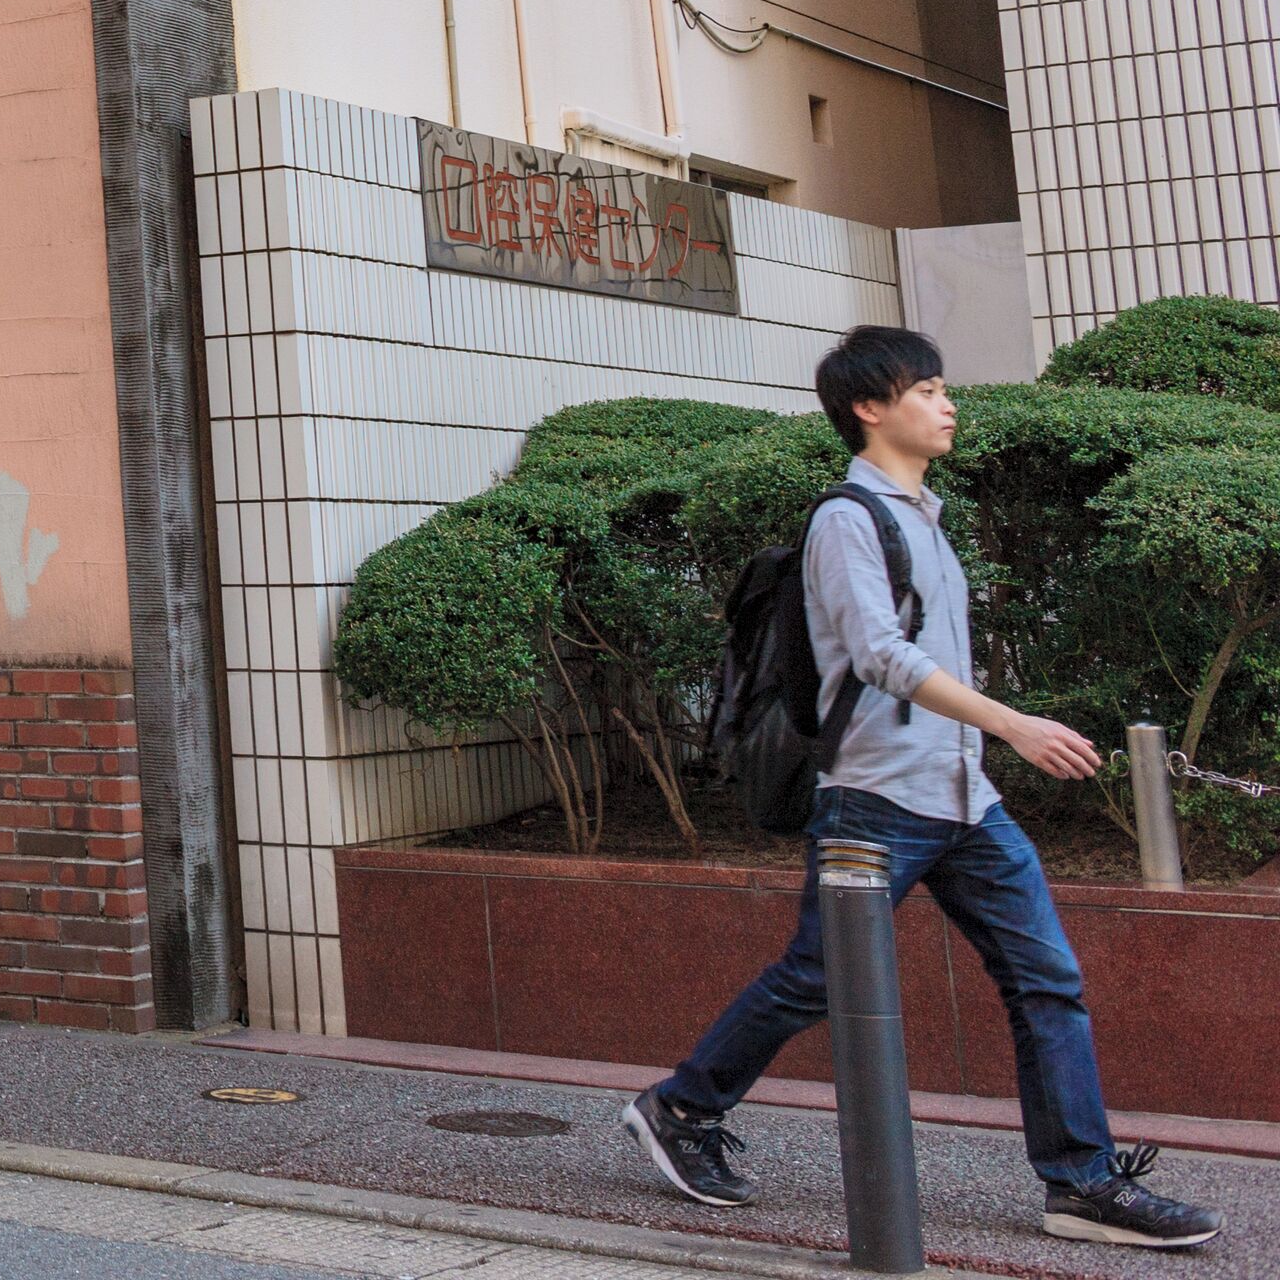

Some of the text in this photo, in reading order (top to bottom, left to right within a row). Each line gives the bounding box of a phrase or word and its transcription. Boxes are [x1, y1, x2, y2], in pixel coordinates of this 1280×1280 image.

[441, 155, 720, 278] 口腔保健センター
[1114, 1191, 1137, 1207] N
